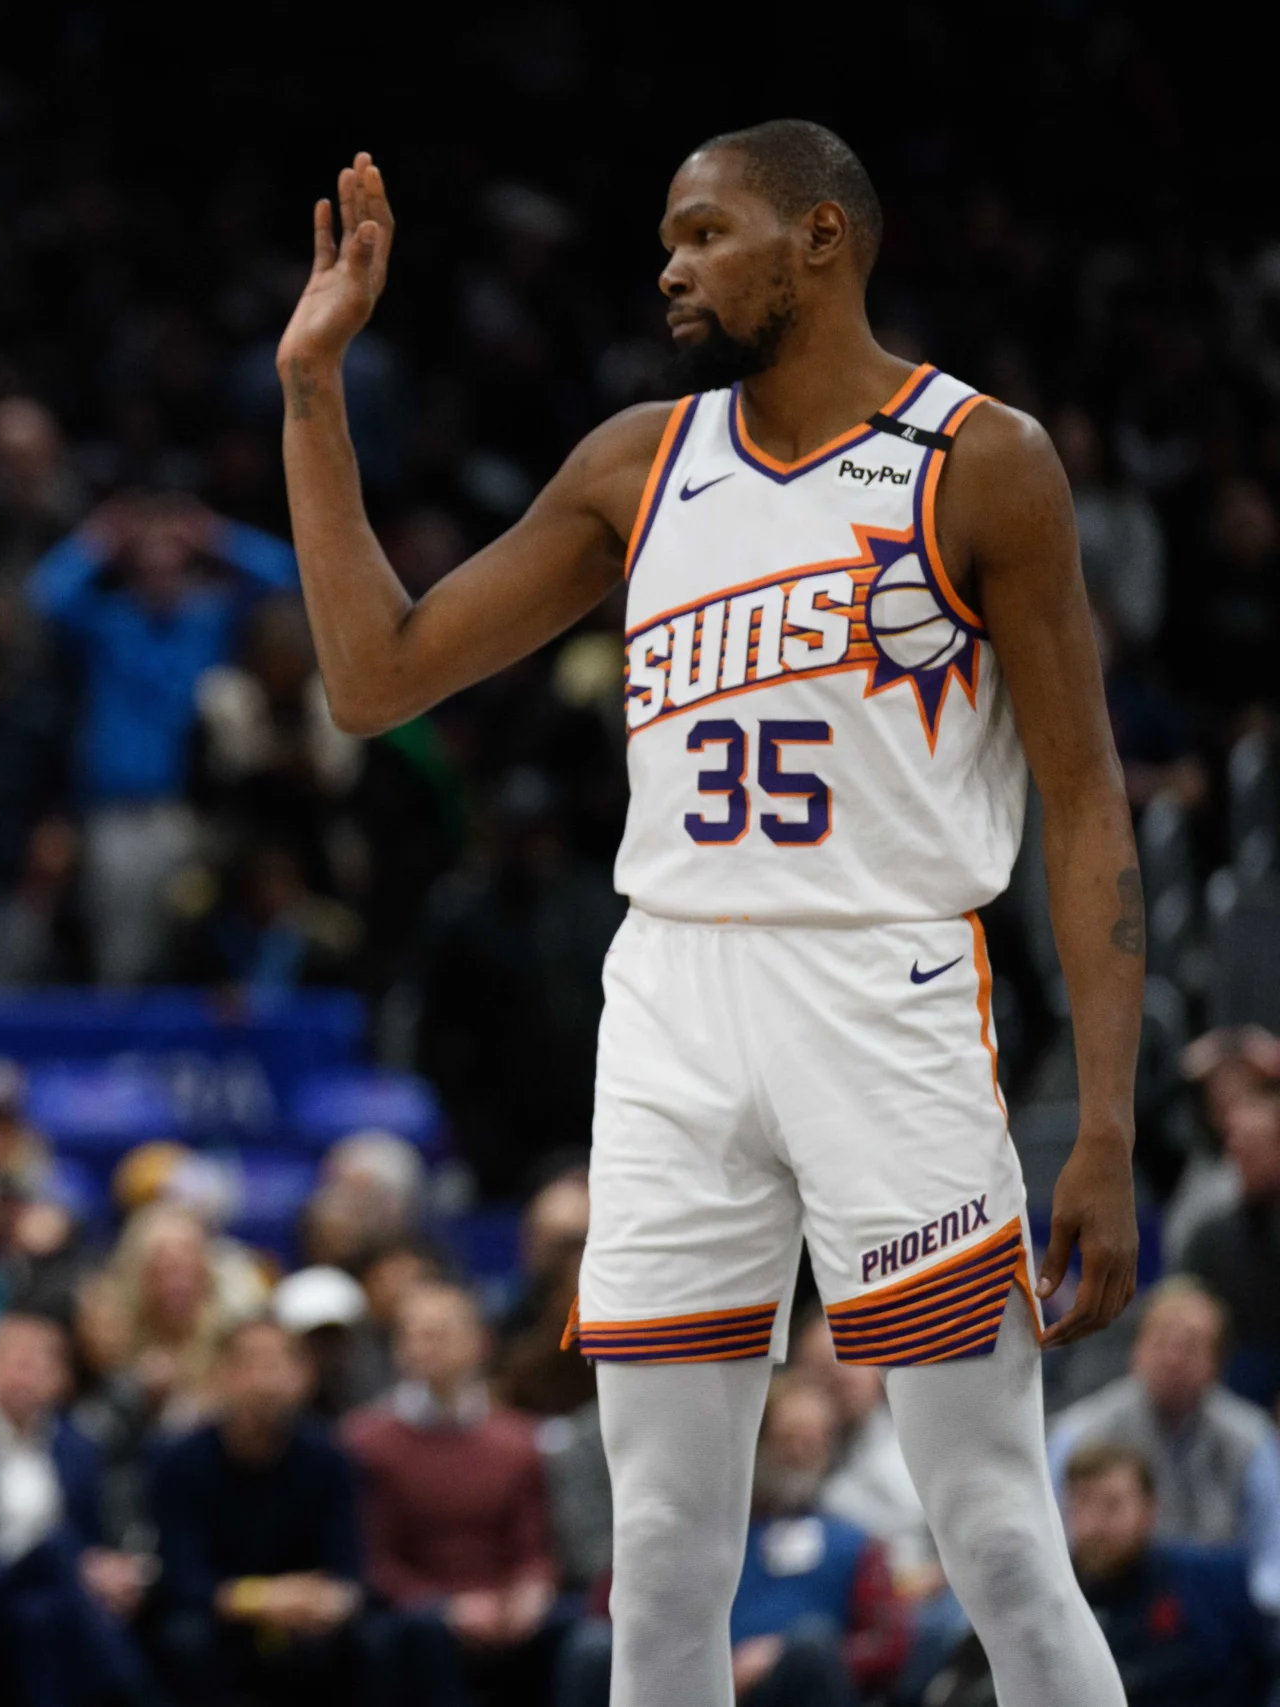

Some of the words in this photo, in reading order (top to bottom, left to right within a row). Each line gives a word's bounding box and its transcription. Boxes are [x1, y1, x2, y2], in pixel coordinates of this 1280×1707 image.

[838, 459, 912, 486] PayPal
[901, 425, 917, 441] AL
[625, 571, 855, 730] SUNS
[684, 718, 834, 847] 35
[861, 1193, 990, 1283] PHOENIX
